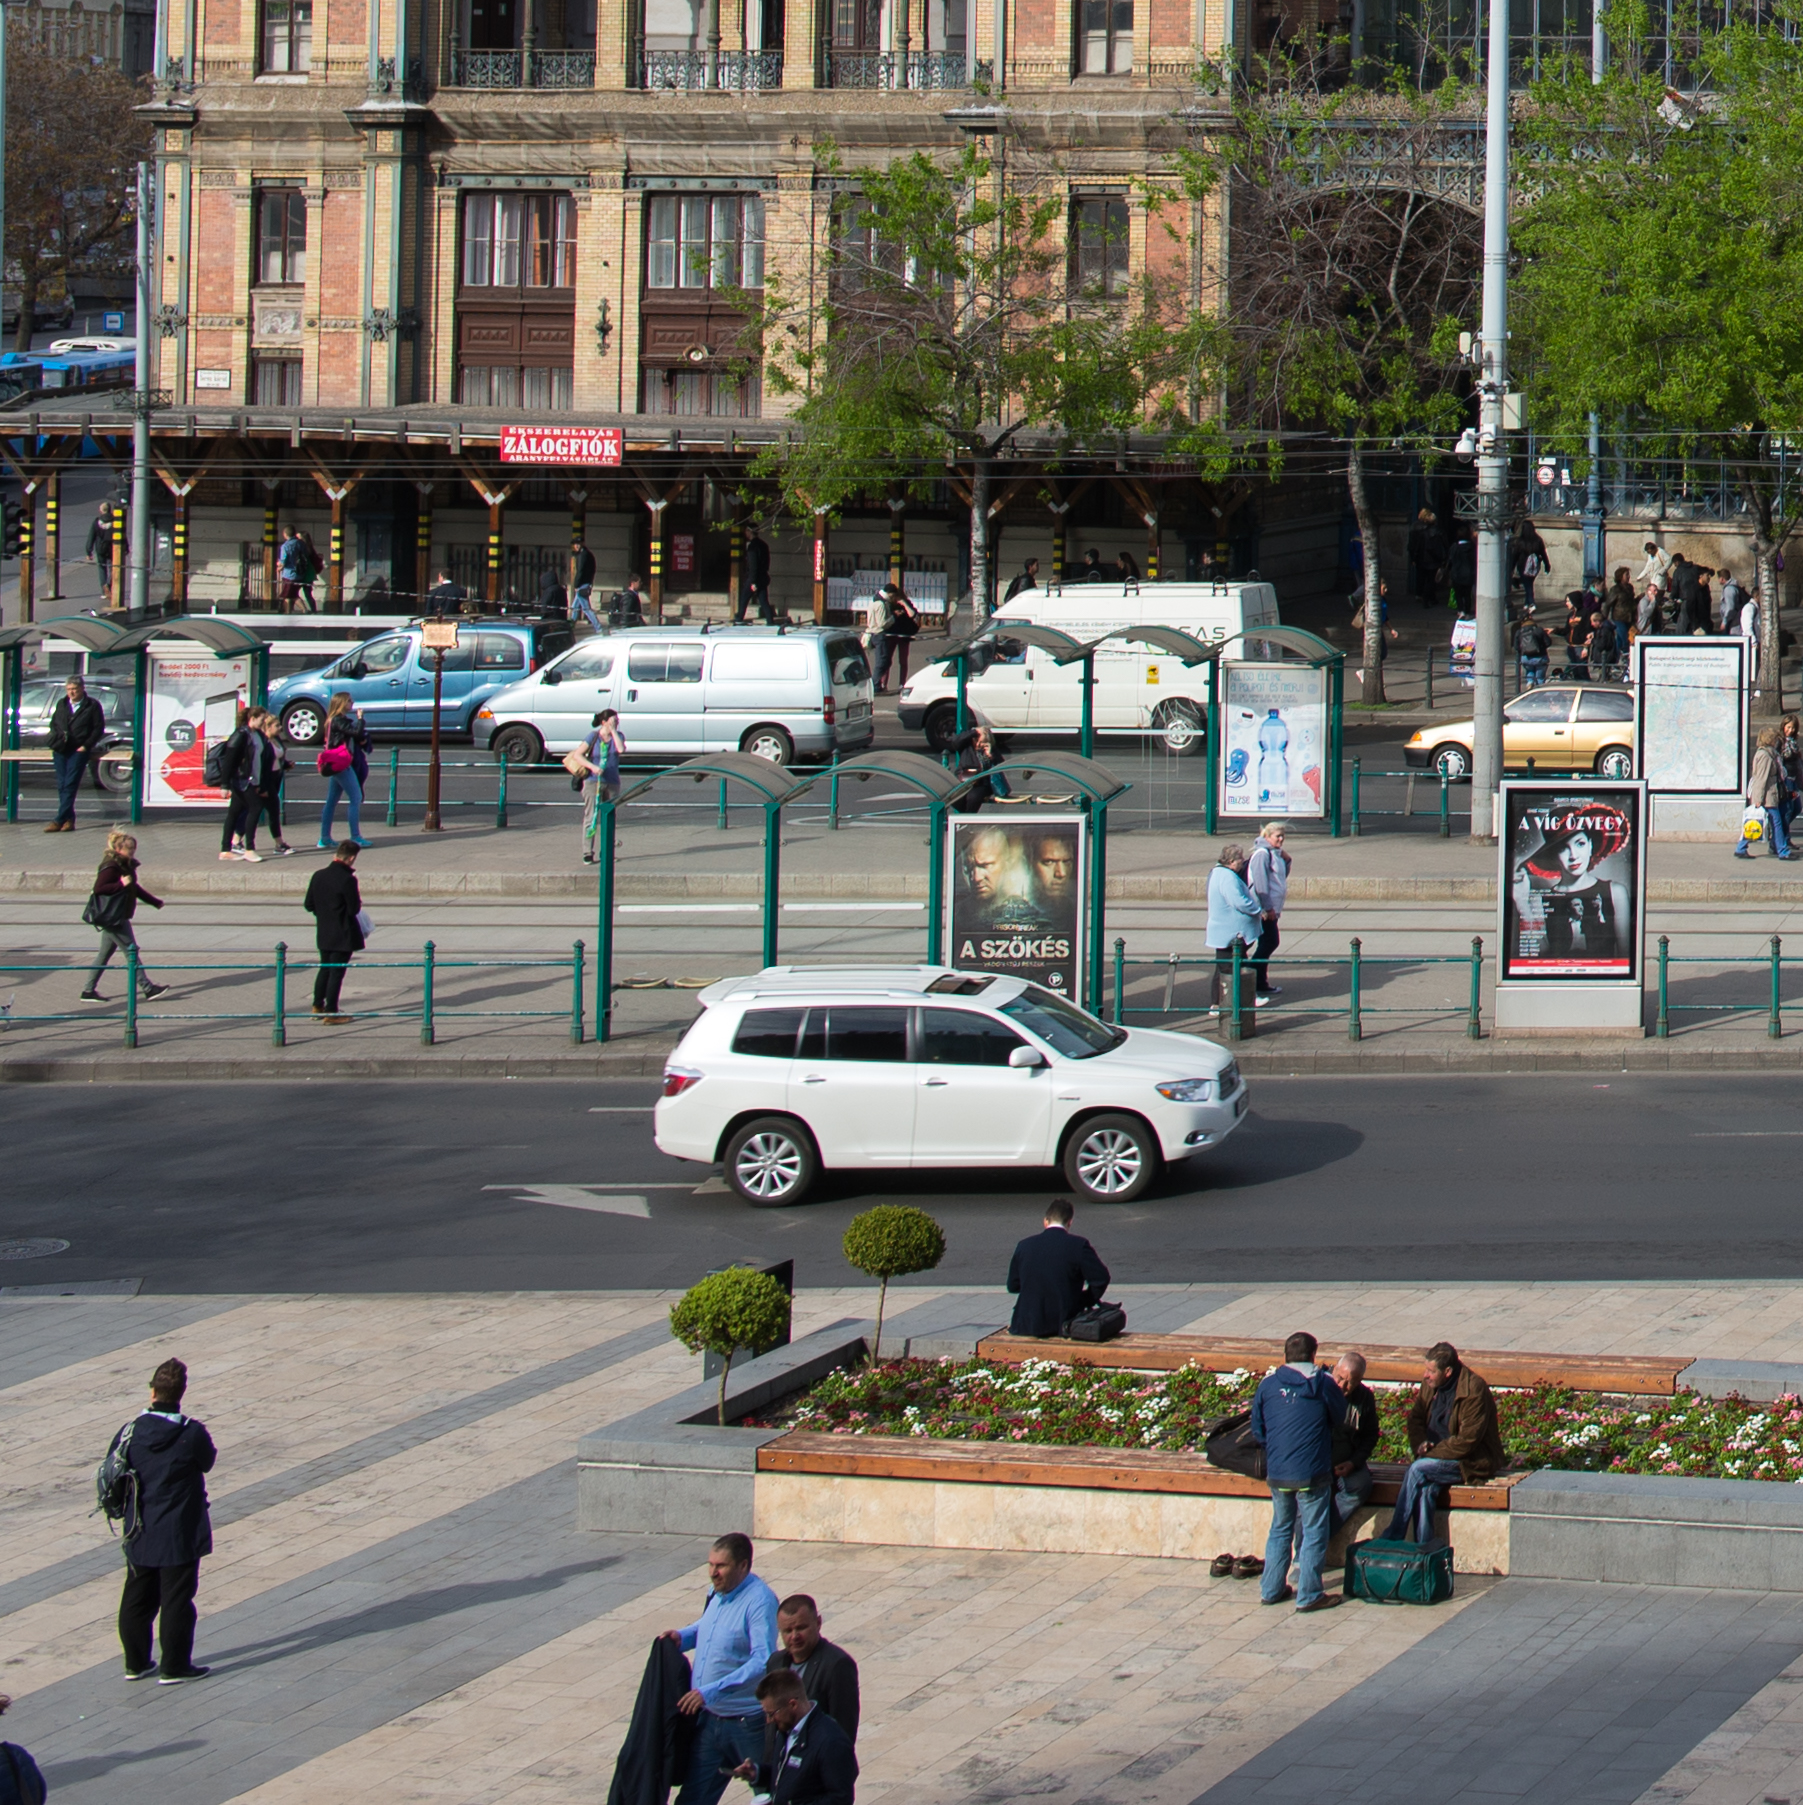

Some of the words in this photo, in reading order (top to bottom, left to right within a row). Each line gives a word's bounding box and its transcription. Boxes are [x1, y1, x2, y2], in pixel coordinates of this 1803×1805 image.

[503, 433, 618, 456] ZÁLOGFIÓK
[1518, 816, 1530, 830] A
[1534, 812, 1561, 830] VÍG
[1565, 812, 1625, 830] ÖZVEGY
[960, 940, 976, 958] A
[980, 935, 1070, 959] SZÖKÉS
